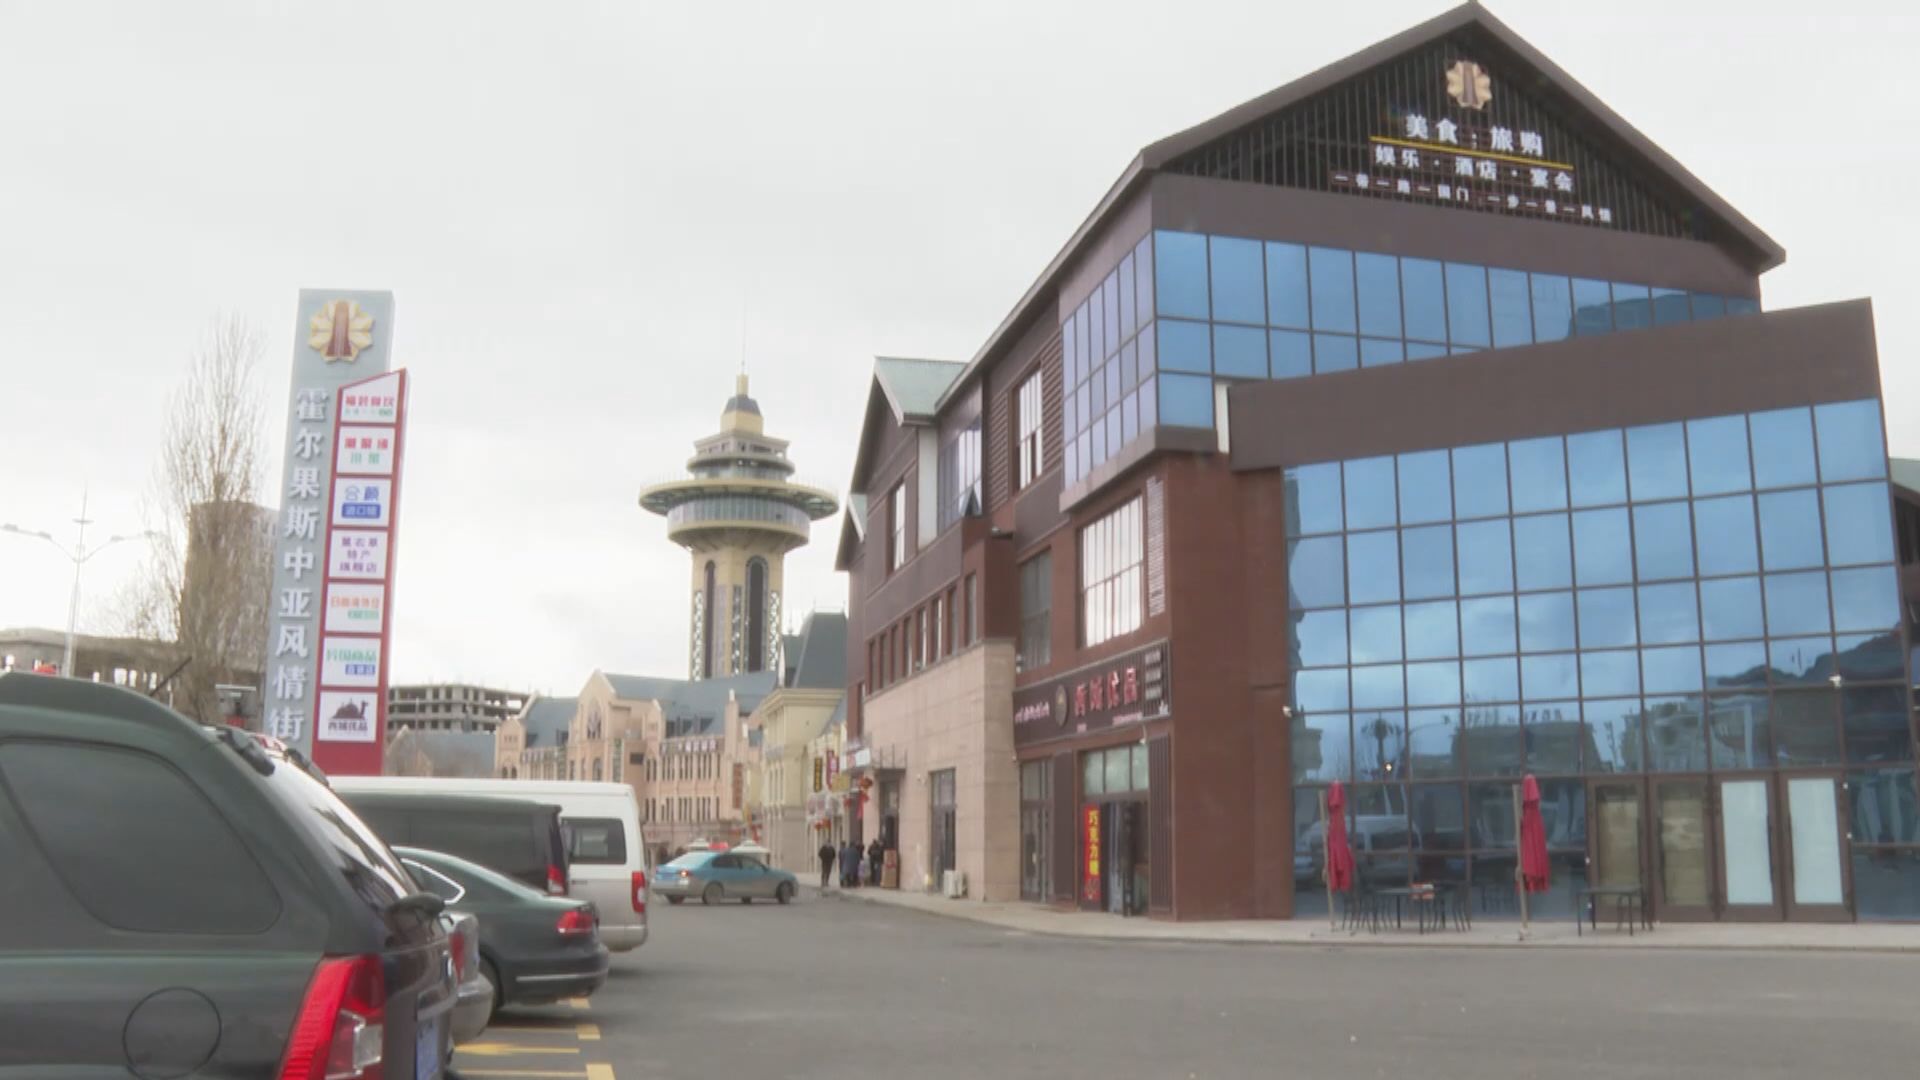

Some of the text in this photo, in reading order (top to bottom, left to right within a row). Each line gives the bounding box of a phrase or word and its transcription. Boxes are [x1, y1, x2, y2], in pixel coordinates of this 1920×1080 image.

[268, 387, 329, 741] 霍尔果斯中亚风情街
